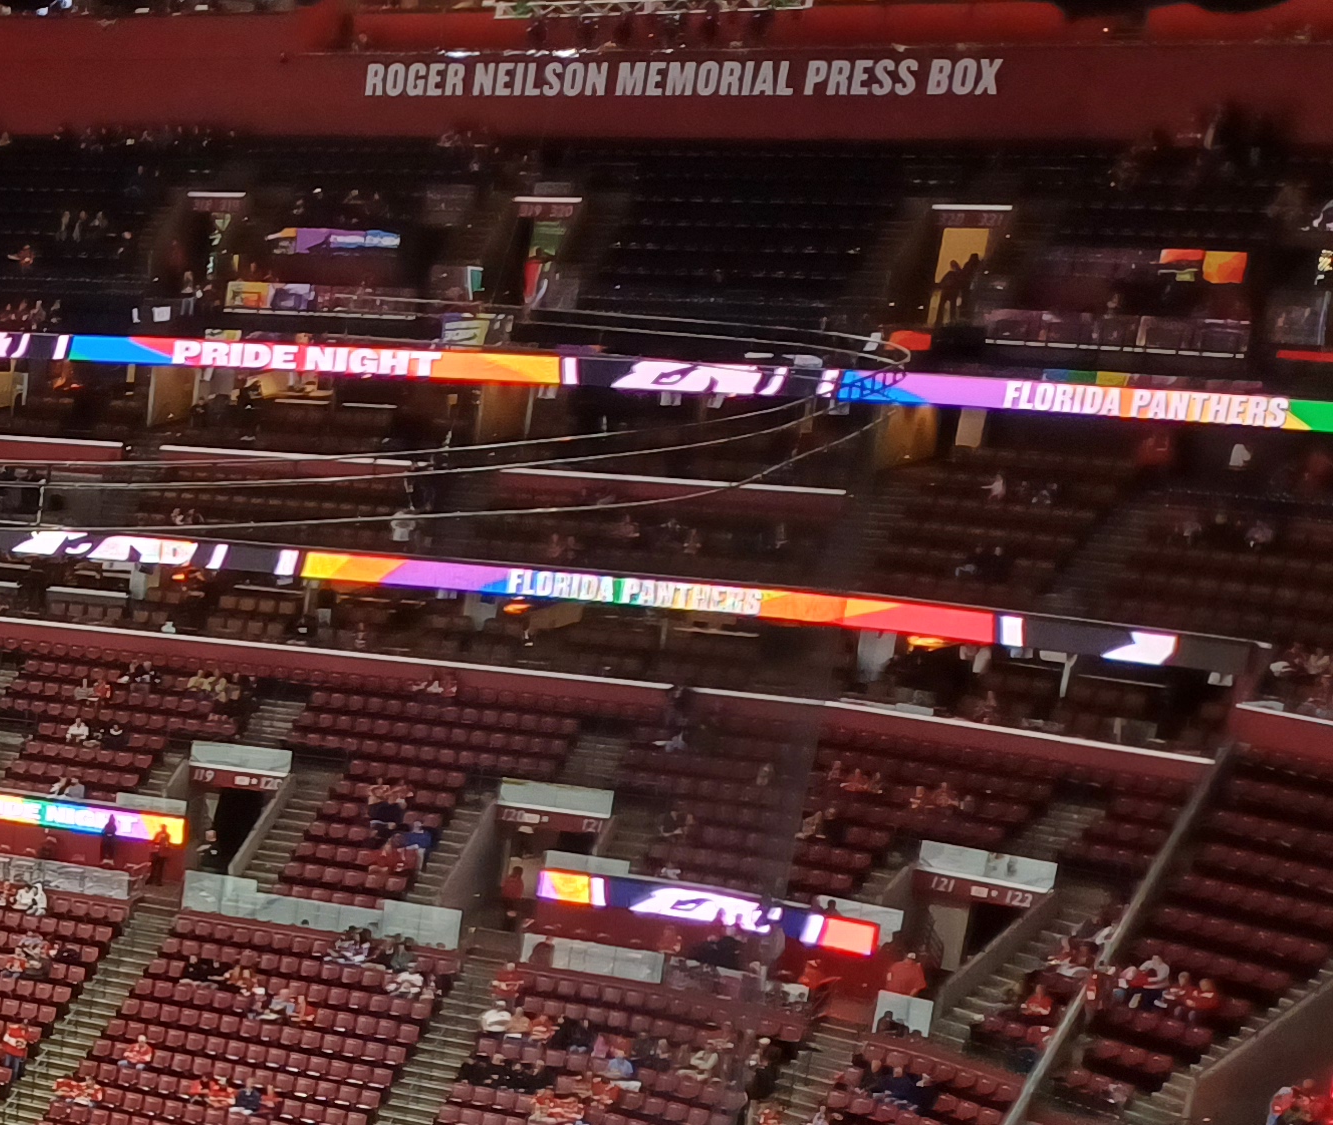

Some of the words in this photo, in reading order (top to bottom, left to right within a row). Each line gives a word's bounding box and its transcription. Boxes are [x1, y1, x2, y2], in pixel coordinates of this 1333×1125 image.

[364, 63, 466, 98] ROGER
[472, 62, 609, 97] NEILSON
[614, 60, 796, 97] MEMORIAL
[804, 59, 918, 97] PRESS
[926, 57, 1003, 96] BOX
[172, 340, 297, 369] PRIDE
[303, 345, 441, 377] NIGHT
[1002, 381, 1120, 416] FLORIDA
[1130, 388, 1290, 428] PANTHERS
[506, 567, 614, 604] FLORIDA
[622, 575, 762, 616] PANTHERS
